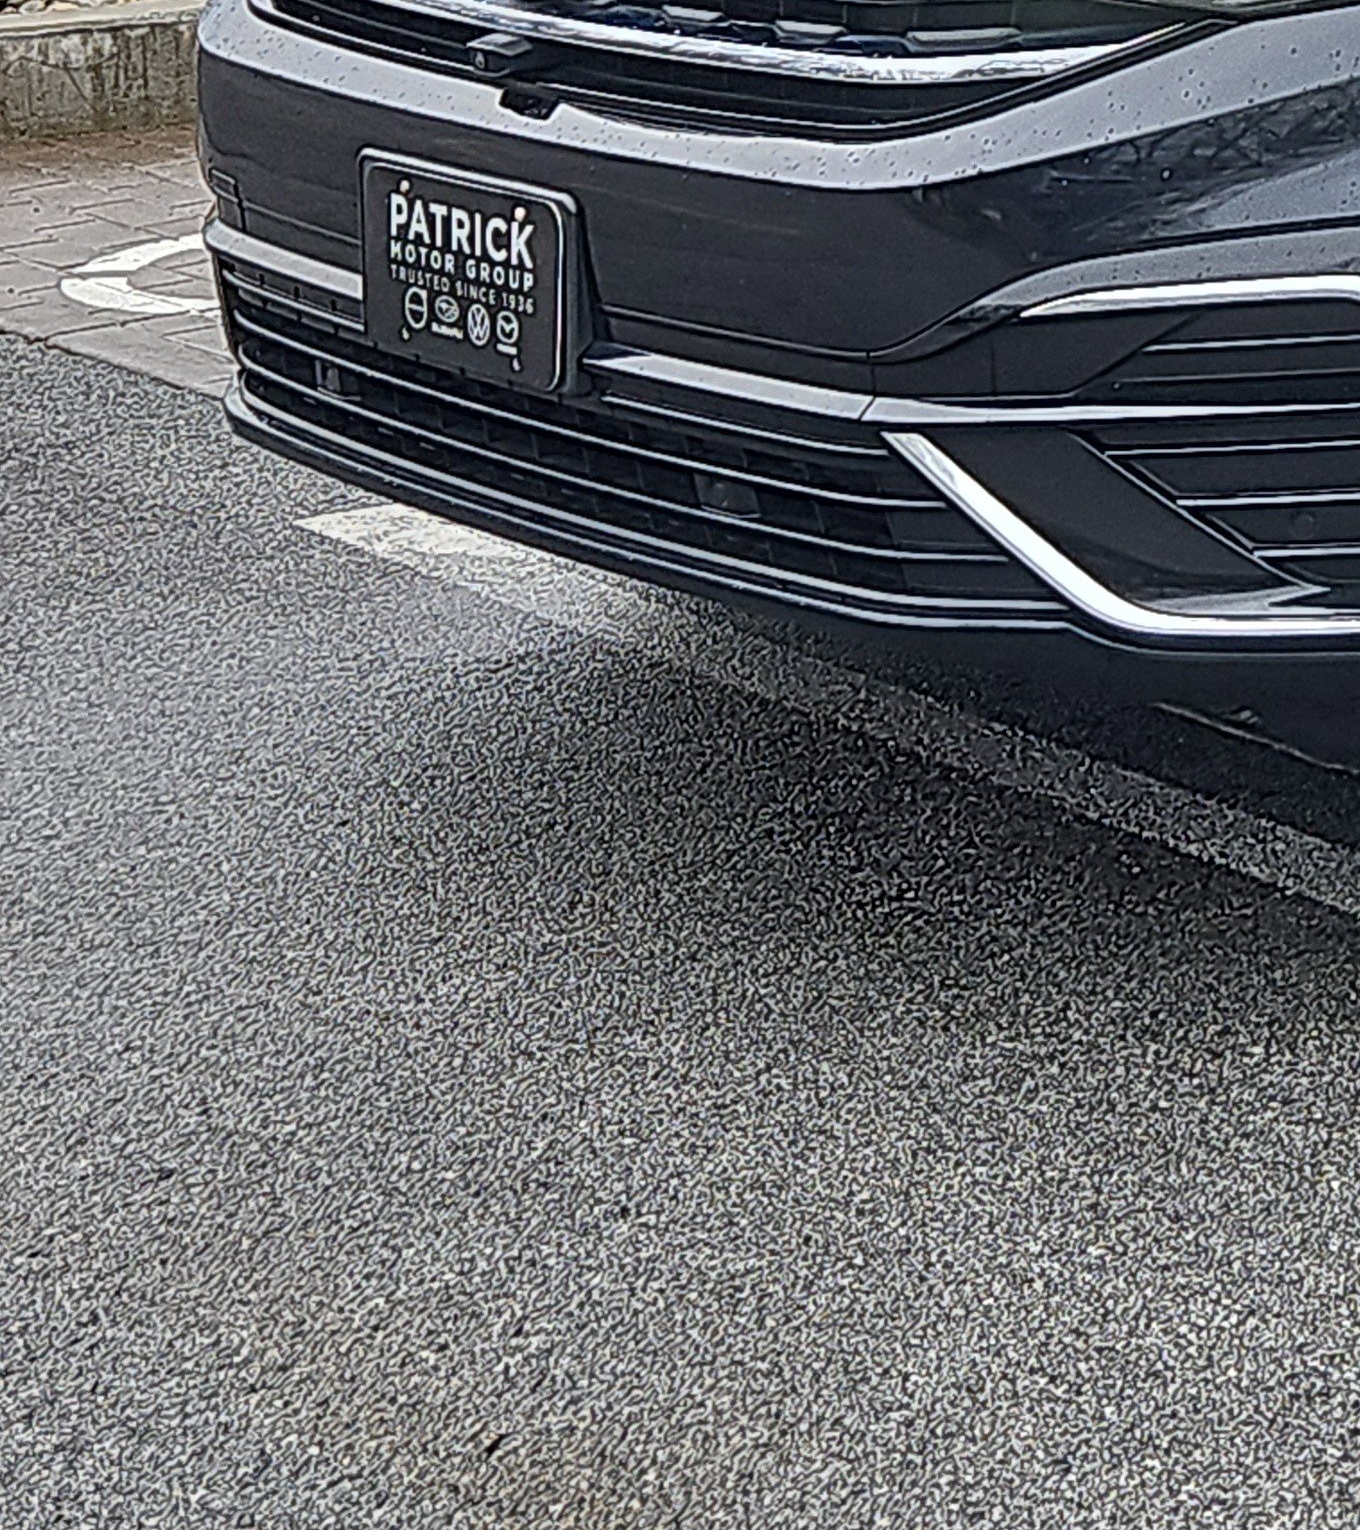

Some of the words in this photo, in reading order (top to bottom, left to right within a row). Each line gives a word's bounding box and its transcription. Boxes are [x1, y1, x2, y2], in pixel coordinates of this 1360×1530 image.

[390, 192, 535, 269] PATRICK
[390, 239, 455, 274] MOTOR
[465, 259, 534, 292] GROUP
[390, 264, 450, 292] TRUSTED
[456, 281, 496, 305] SINCE
[502, 292, 534, 314] 1936
